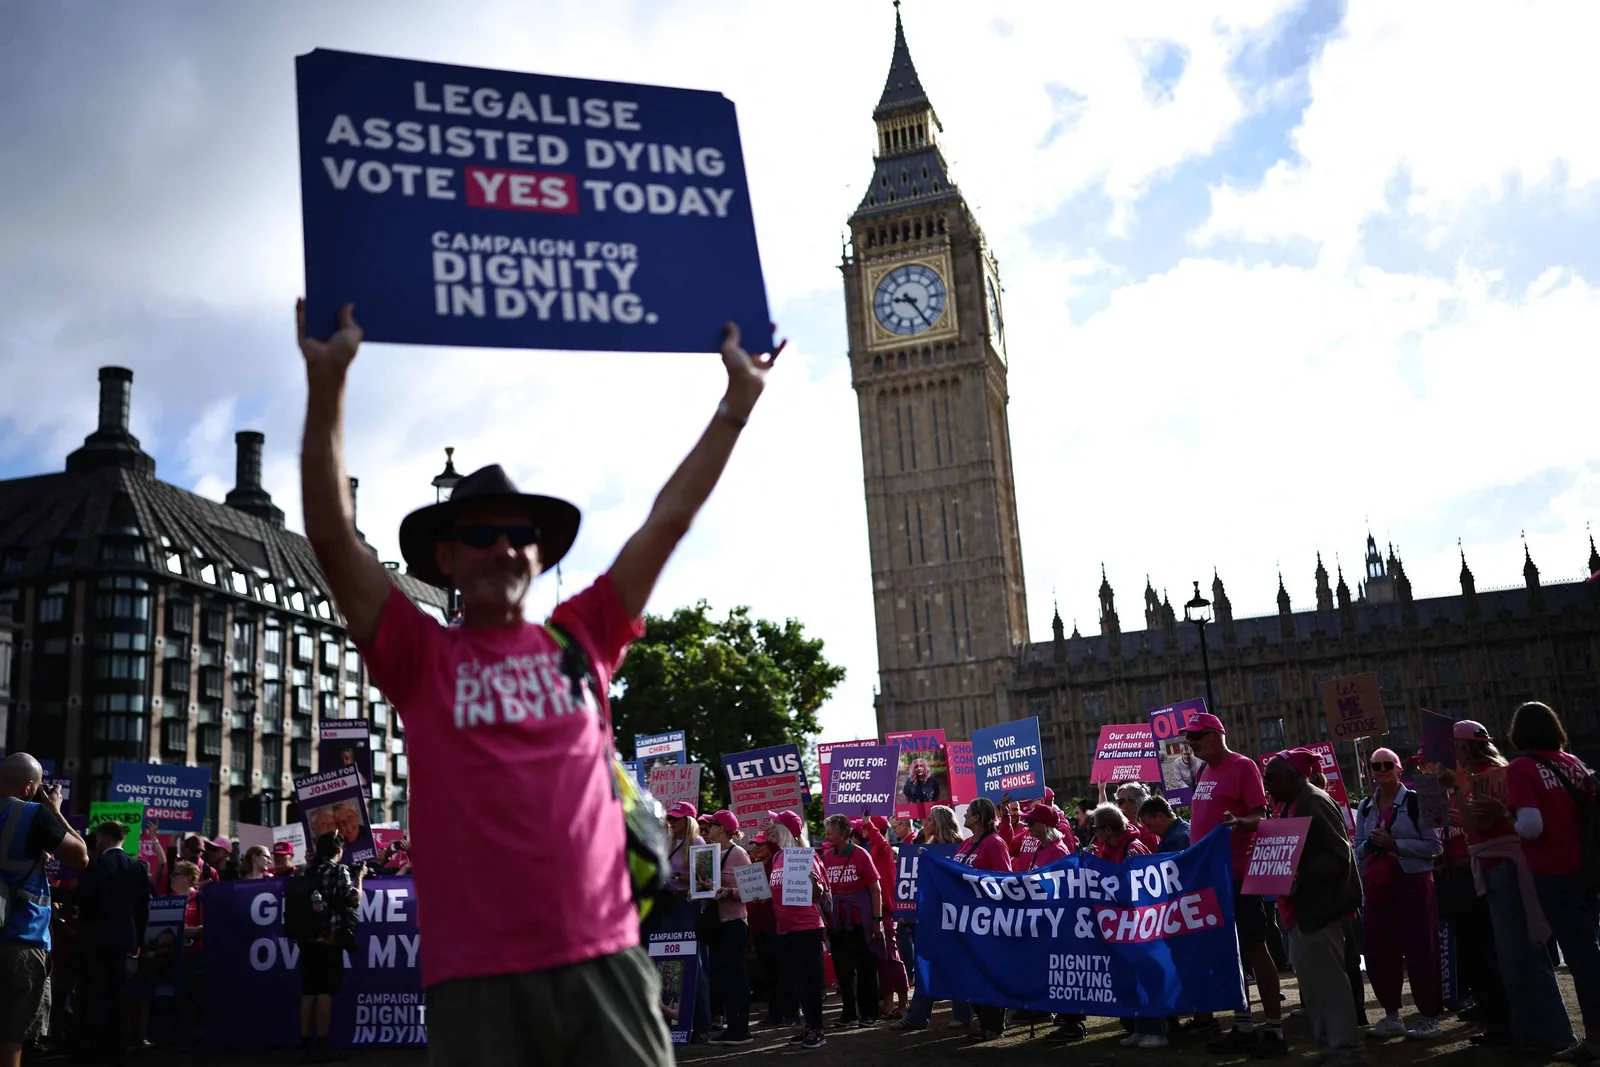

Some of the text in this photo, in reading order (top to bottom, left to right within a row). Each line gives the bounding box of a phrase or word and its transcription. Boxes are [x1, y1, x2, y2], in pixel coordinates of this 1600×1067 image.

[414, 80, 641, 131] LEGALISE
[326, 114, 726, 178] ASSISTED DYING
[322, 157, 734, 218] VOTE YES TODAY
[432, 230, 638, 260] CAMPAIGN FOR
[433, 251, 638, 291] DIGNITY
[436, 284, 659, 325] IN DYING.
[1337, 681, 1357, 696] Let
[454, 700, 497, 729] IN
[320, 720, 367, 728] CAMPAIGN FOR
[1335, 718, 1378, 736] CHOOSE
[636, 733, 682, 747] CAMPAIGN FOR
[994, 736, 1016, 748] YOUR
[1104, 741, 1142, 749] continues
[648, 745, 670, 754] CHRIS
[977, 746, 1037, 766] CONSTITUENTS
[1098, 750, 1142, 759] Parliament
[726, 754, 799, 781] LET US
[843, 758, 887, 768] VOTE FOR:
[986, 761, 1030, 778] ARE DYING
[146, 774, 177, 785] YOUR
[296, 766, 355, 788] CAMPAIGN FOR
[652, 768, 692, 781] WHEN WE
[840, 770, 871, 780] CHOICE
[984, 774, 1035, 791] FOR CHOICE.
[116, 783, 202, 798] CONSTITUENTS
[309, 780, 348, 796] JOANNA
[838, 782, 861, 791] HOPE
[154, 797, 189, 809] DYING
[838, 793, 890, 803] DEMOCRACY
[146, 809, 192, 820] CHOICE.
[1256, 835, 1299, 845] CAMPAIGN FOR
[1252, 845, 1297, 861] DIGNITY
[1248, 861, 1292, 876] IN DYING.
[962, 860, 1183, 902] TOGETHER FOR
[358, 889, 408, 922] ME
[941, 894, 1218, 941] DIGNITY & CHOICE.
[649, 931, 697, 941] CAMPAIGN FOR
[368, 935, 421, 968] MY
[664, 944, 680, 954] ROB
[1049, 954, 1111, 971] DIGNITY
[1049, 970, 1112, 988] IN DYING
[357, 993, 418, 1004] CAMPAIGN
[1049, 987, 1116, 1003] SCOTLAND.
[356, 1006, 427, 1025] DIGNIT
[352, 1026, 427, 1043] IN DYIN
